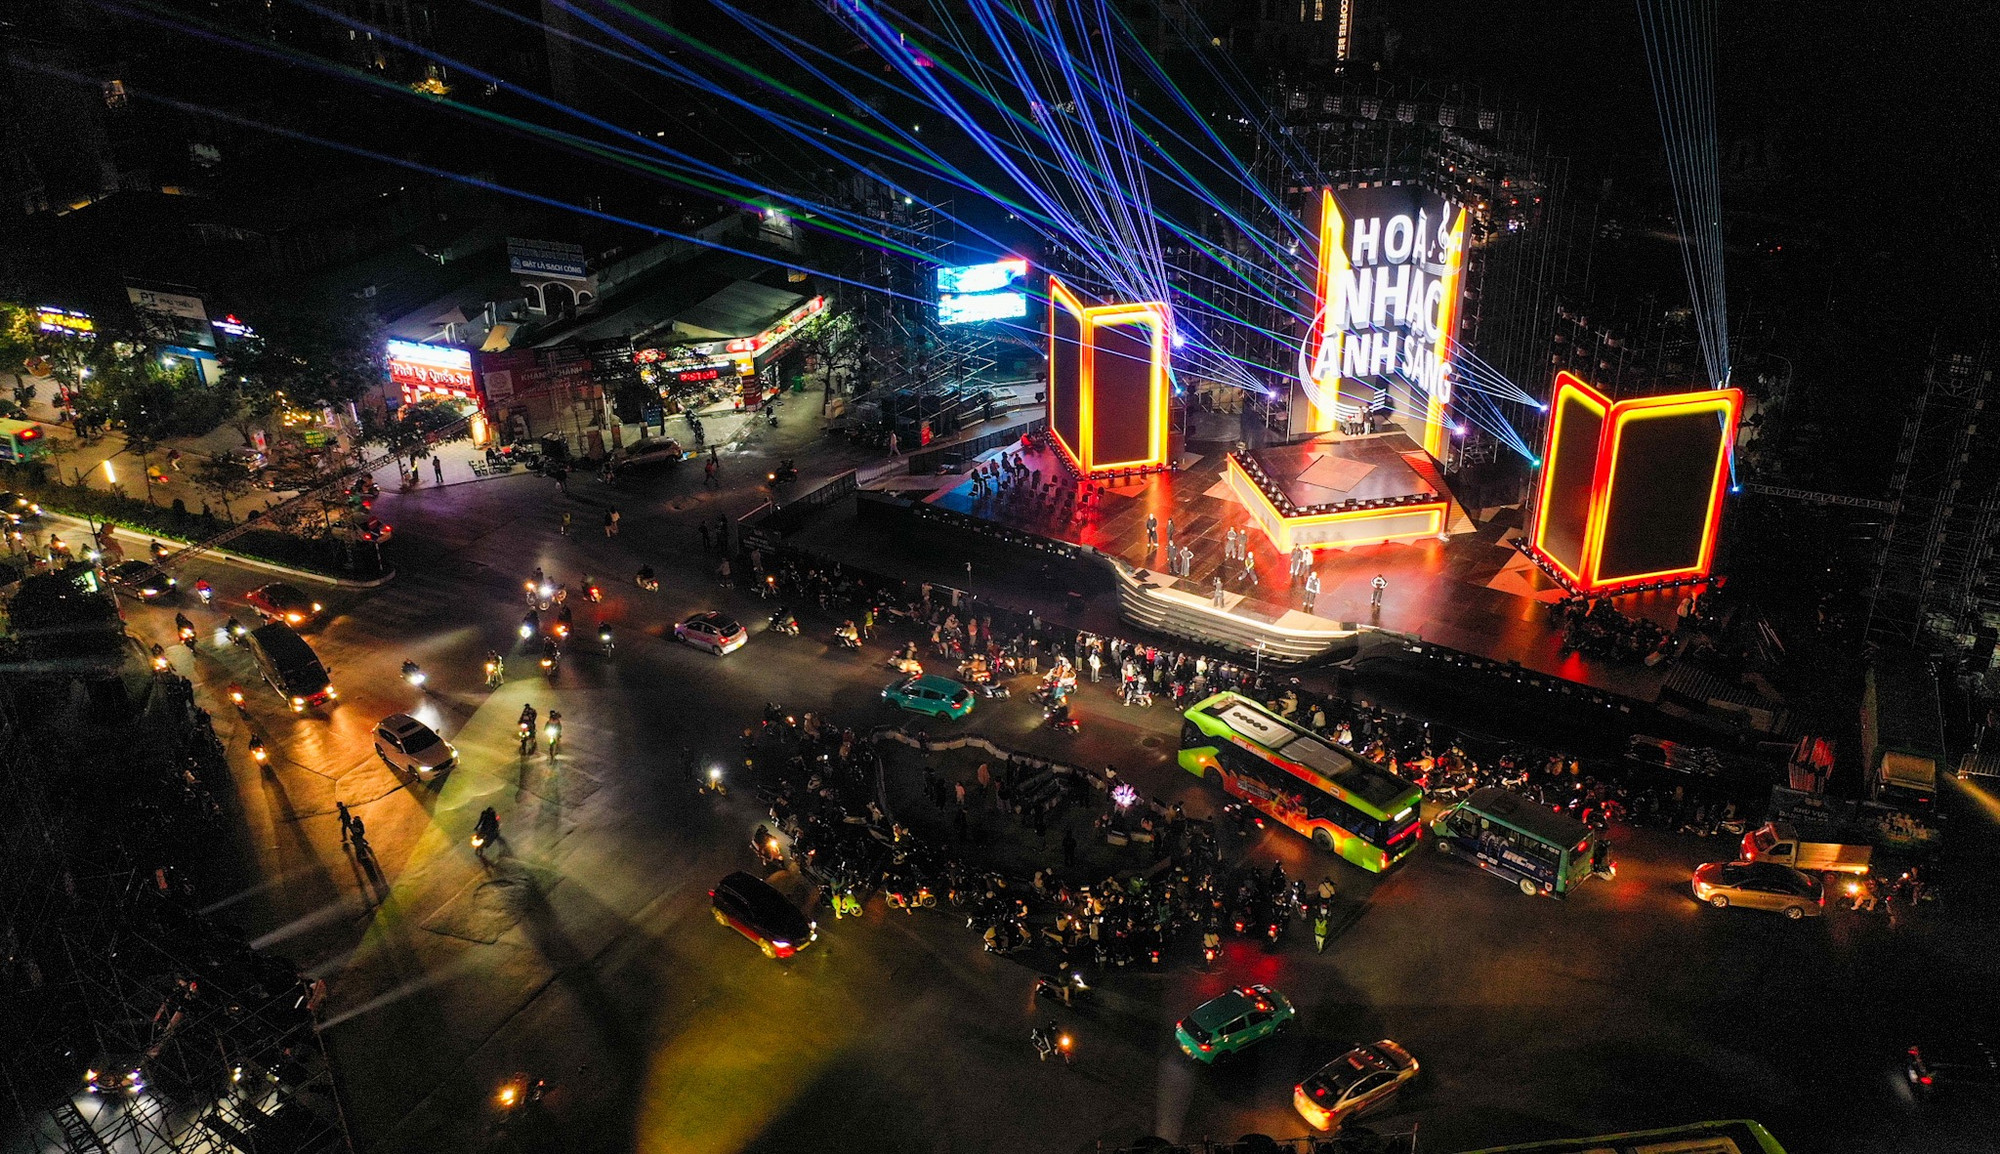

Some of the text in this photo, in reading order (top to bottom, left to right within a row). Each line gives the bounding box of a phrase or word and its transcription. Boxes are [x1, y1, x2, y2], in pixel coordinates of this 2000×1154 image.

[1338, 0, 1349, 37] COFFEE
[1352, 207, 1428, 268] HOÀ
[1336, 265, 1444, 344] NHẠC
[1312, 331, 1453, 405] ÁNH SÁNG
